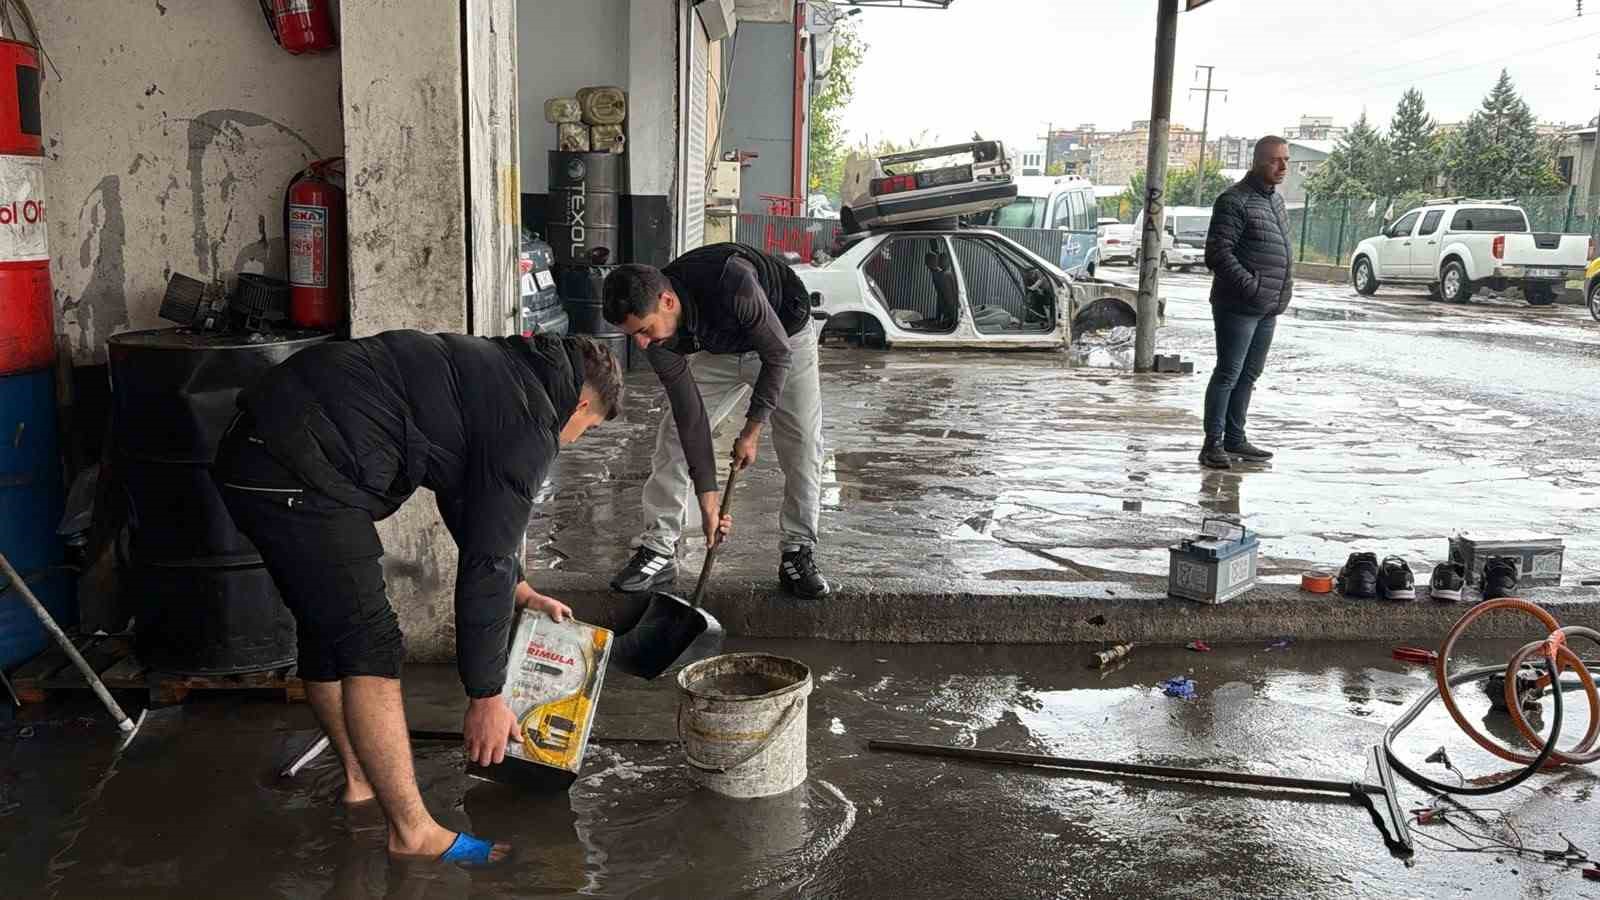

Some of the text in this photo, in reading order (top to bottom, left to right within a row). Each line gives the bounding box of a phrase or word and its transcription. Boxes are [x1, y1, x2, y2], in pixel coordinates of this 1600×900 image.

[0, 200, 18, 225] ol
[571, 181, 585, 258] TEXOL
[527, 647, 575, 666] RIMULA
